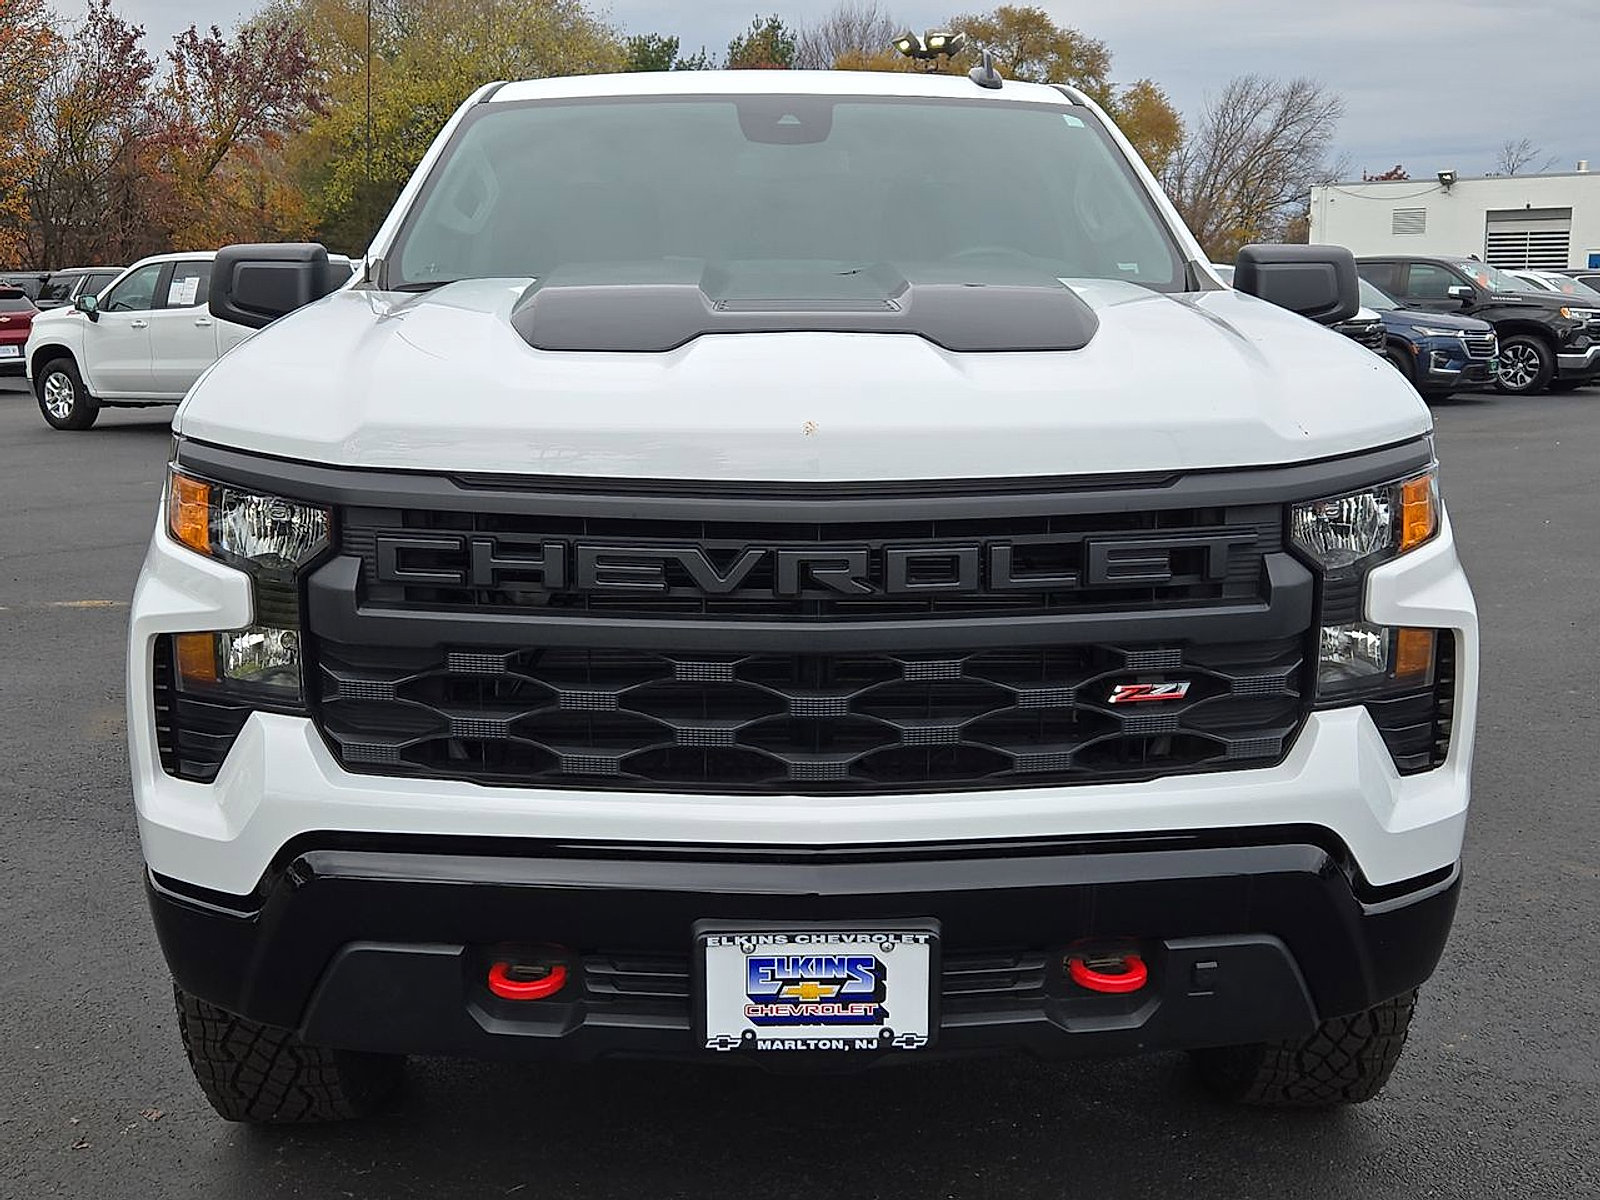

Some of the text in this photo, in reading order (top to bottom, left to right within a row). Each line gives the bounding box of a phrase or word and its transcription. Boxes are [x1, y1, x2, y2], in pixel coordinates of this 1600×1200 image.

[376, 532, 1259, 594] CHEVROLET
[707, 934, 930, 946] ELKINS CHEVROLET
[747, 956, 875, 994] ELKINS
[745, 1003, 878, 1016] CHEVROLET
[757, 1039, 878, 1051] MARLTON, NJ
